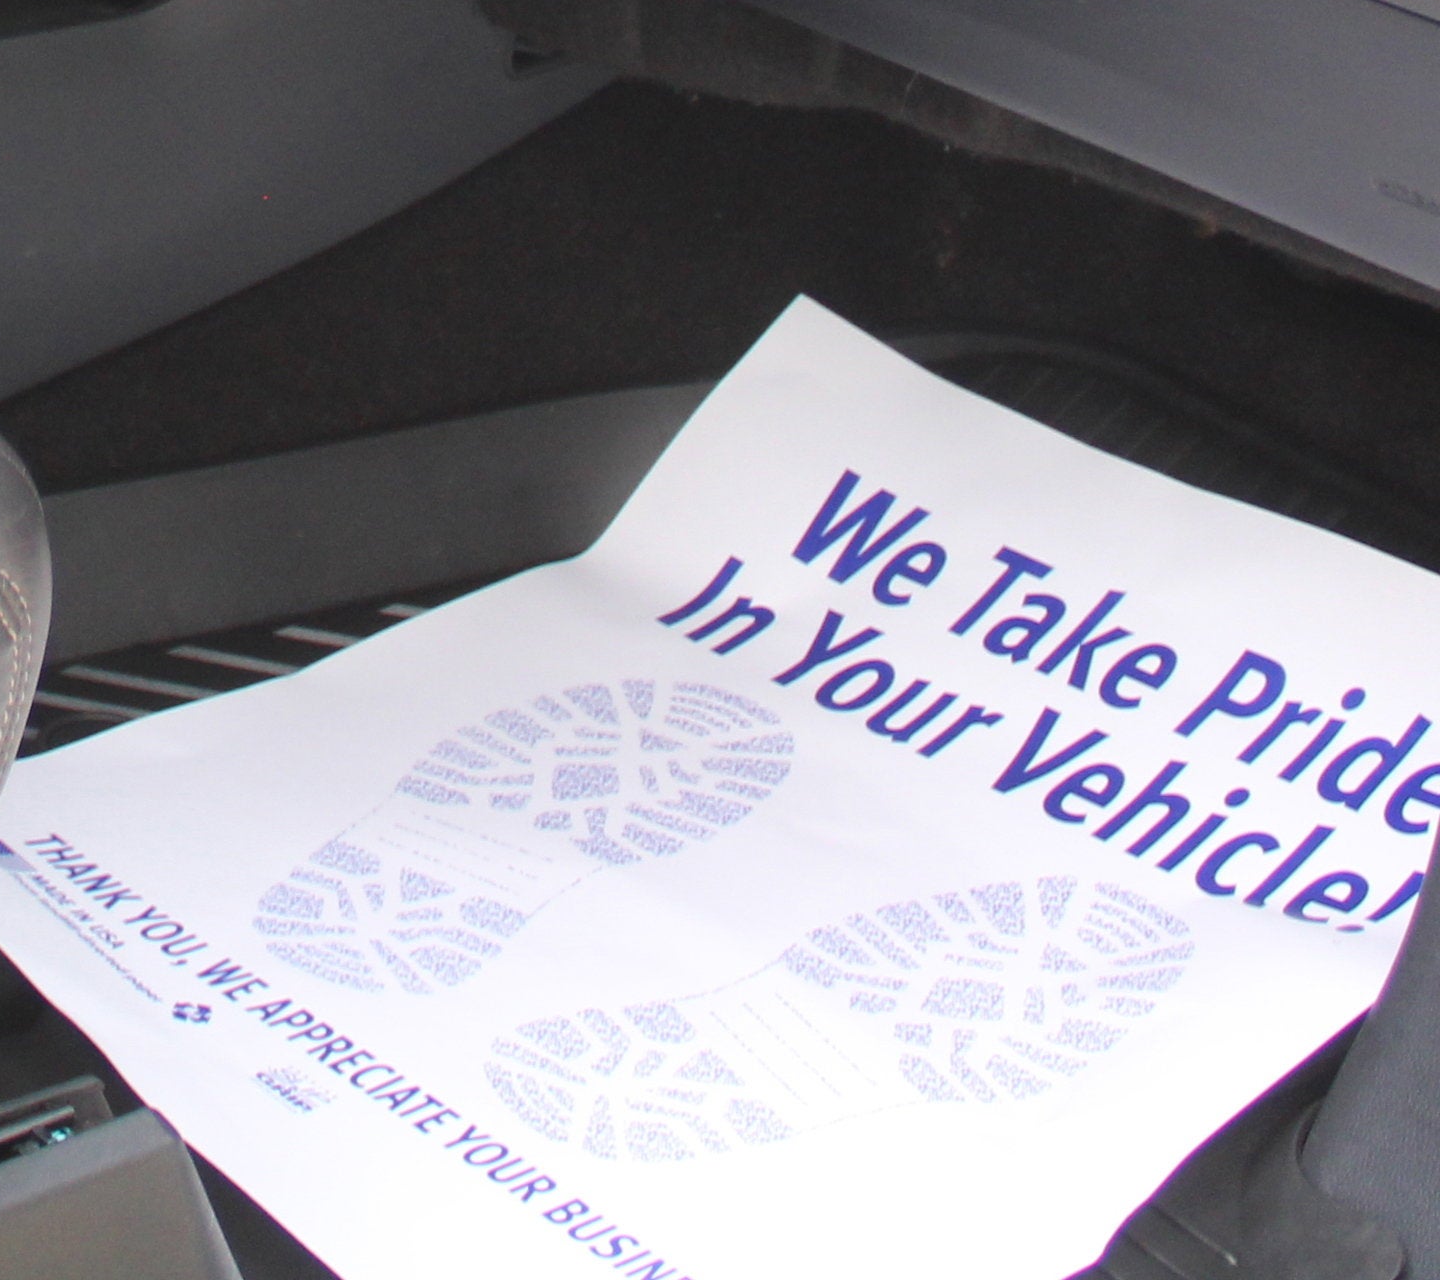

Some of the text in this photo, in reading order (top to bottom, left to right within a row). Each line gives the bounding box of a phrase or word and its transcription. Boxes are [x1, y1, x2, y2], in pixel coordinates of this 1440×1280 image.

[659, 556, 776, 655] In
[773, 609, 1005, 758] Your
[792, 469, 948, 607] We
[949, 545, 1179, 710] Take
[89, 924, 126, 950] USA
[24, 832, 142, 910] THANK
[123, 904, 209, 967] YOU,
[196, 956, 270, 1003] WE
[245, 997, 462, 1135] APPRECIATE
[443, 1123, 557, 1204] YOUR
[540, 1196, 696, 1280] BUSIN
